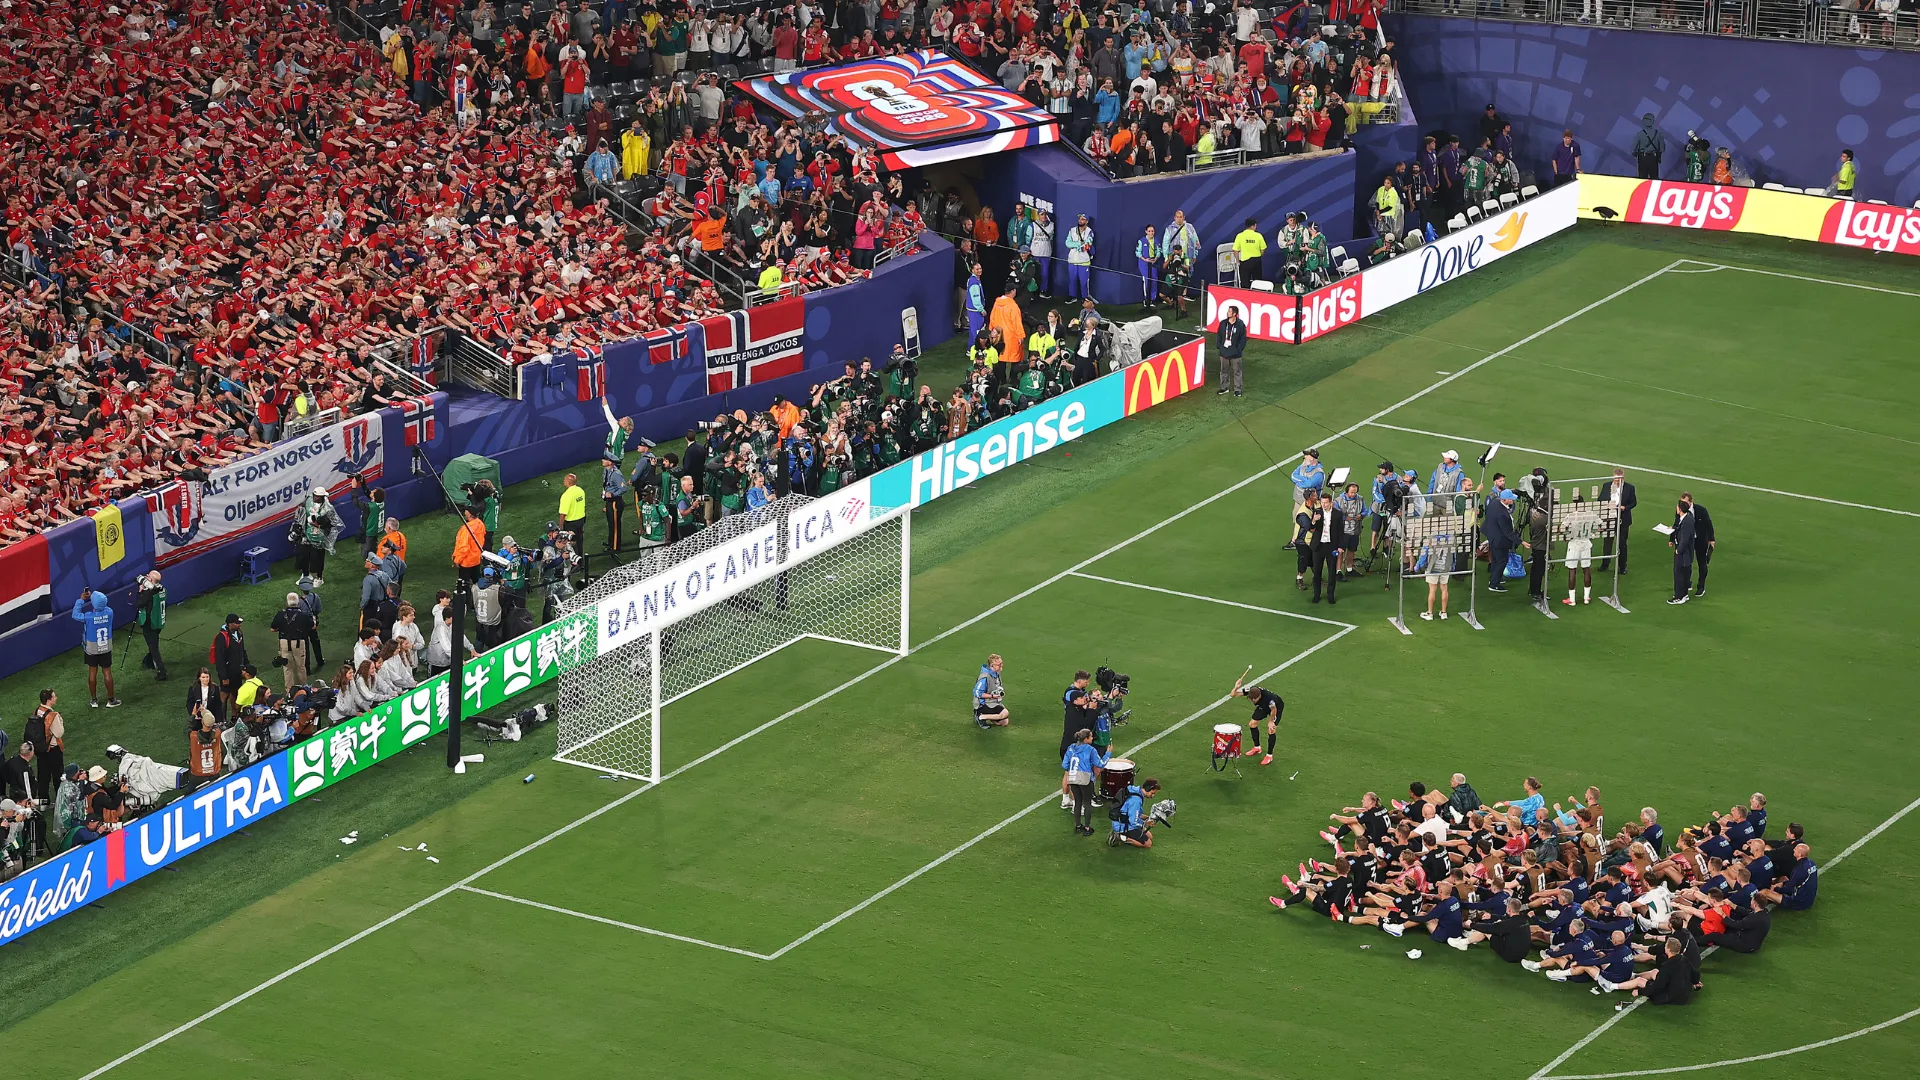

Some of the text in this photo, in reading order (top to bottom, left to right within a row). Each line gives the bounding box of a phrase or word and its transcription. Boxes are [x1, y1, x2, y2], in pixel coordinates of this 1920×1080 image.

[893, 111, 923, 120] WORLD
[899, 112, 948, 125] 2026
[1020, 192, 1034, 207] WE
[1641, 179, 1733, 228] Lay's
[1835, 200, 1920, 252] Lay's
[1416, 234, 1483, 294] Dove
[768, 337, 798, 353] KOKOS
[202, 474, 231, 499] ALT
[234, 461, 271, 487] FOR
[273, 433, 334, 472] NORGE
[910, 401, 1086, 509] Hisense
[224, 476, 312, 522] Oljeberget
[607, 509, 834, 638] BANK OF AMEICA
[329, 712, 388, 777] 蒙牛
[139, 763, 283, 867] ULTRA
[0, 851, 94, 939] ichelob
